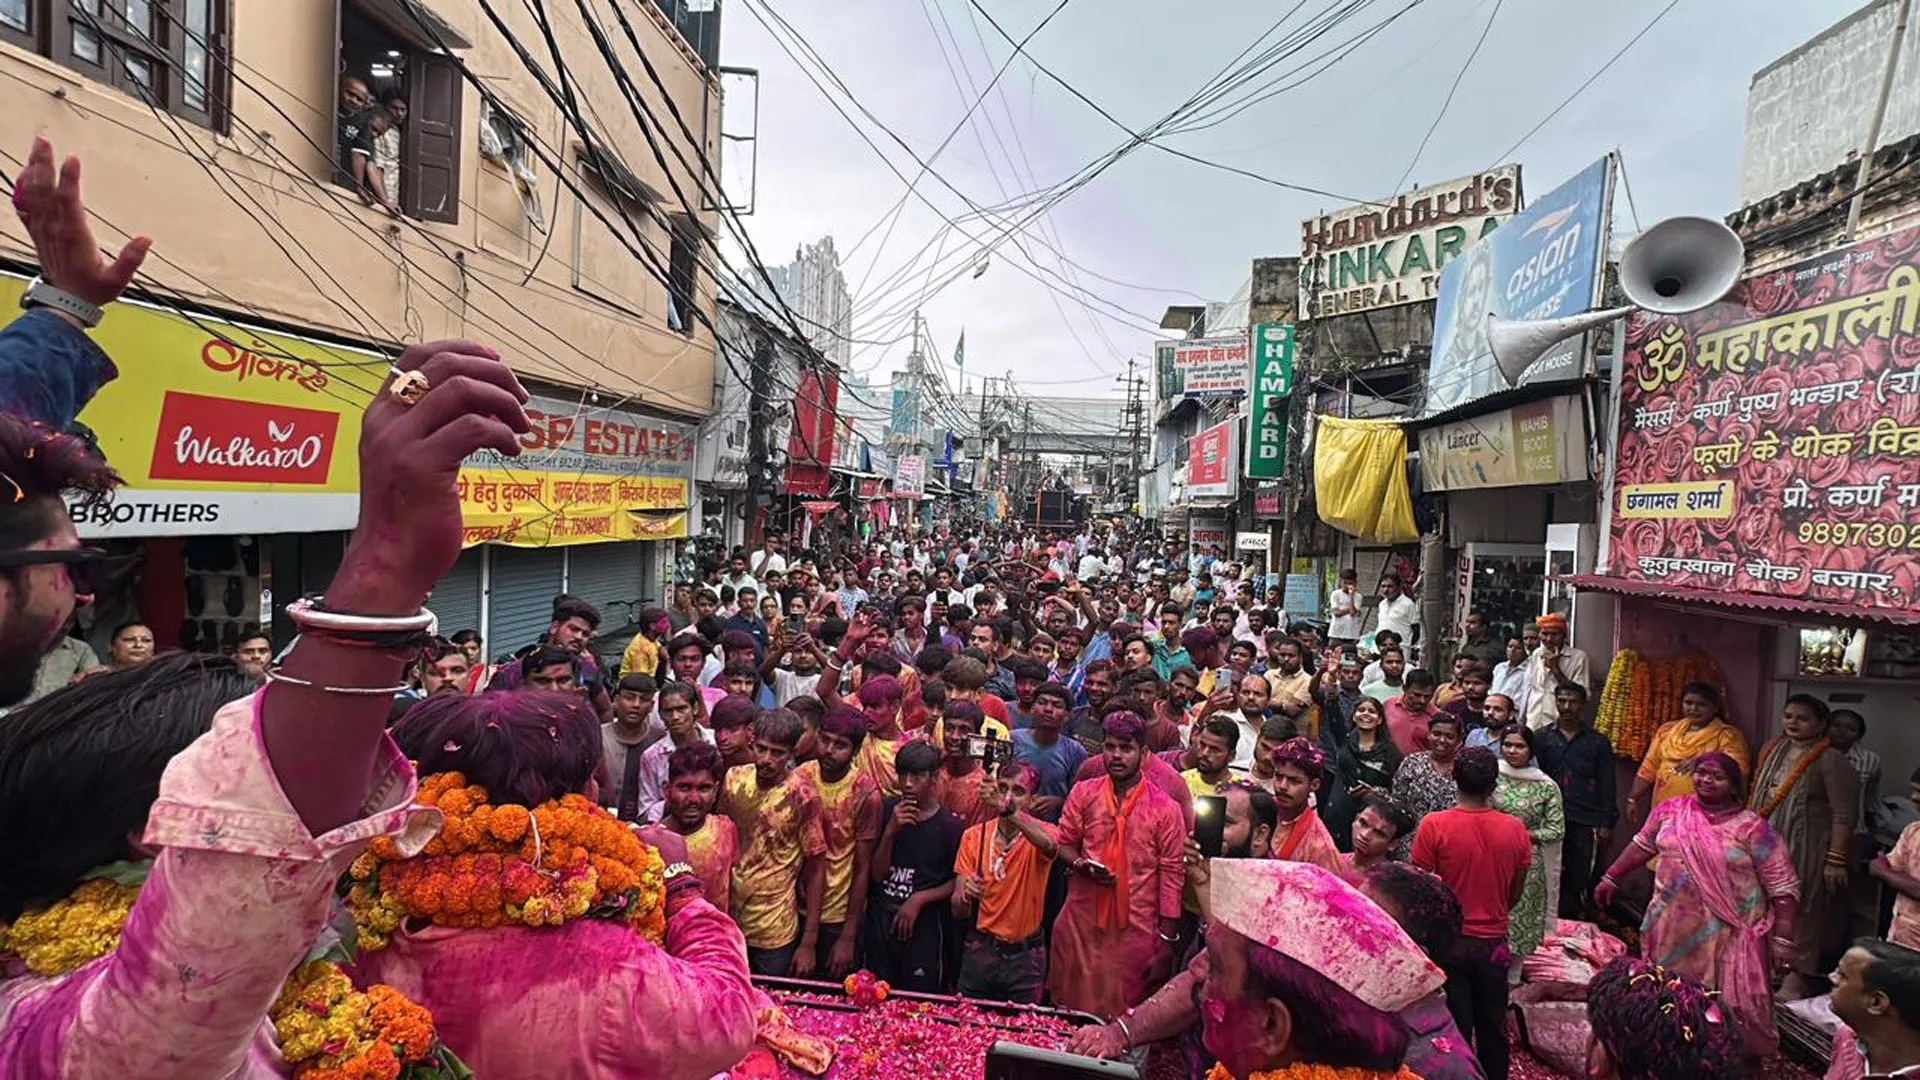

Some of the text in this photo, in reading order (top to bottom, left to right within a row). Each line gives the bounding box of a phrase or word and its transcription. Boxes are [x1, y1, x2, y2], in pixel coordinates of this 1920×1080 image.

[1507, 222, 1581, 300] asian
[1697, 266, 1920, 371] महाकाली
[1693, 391, 1735, 421] कर्ण
[1448, 431, 1481, 450] Lancer
[1753, 430, 1777, 461] के
[1792, 427, 1853, 457] थोक
[473, 475, 499, 512] हेतु
[1687, 483, 1726, 510] शर्मा
[1829, 475, 1891, 508] कर्ण
[69, 503, 219, 523] BROTHERS
[1746, 558, 1799, 583] चौक
